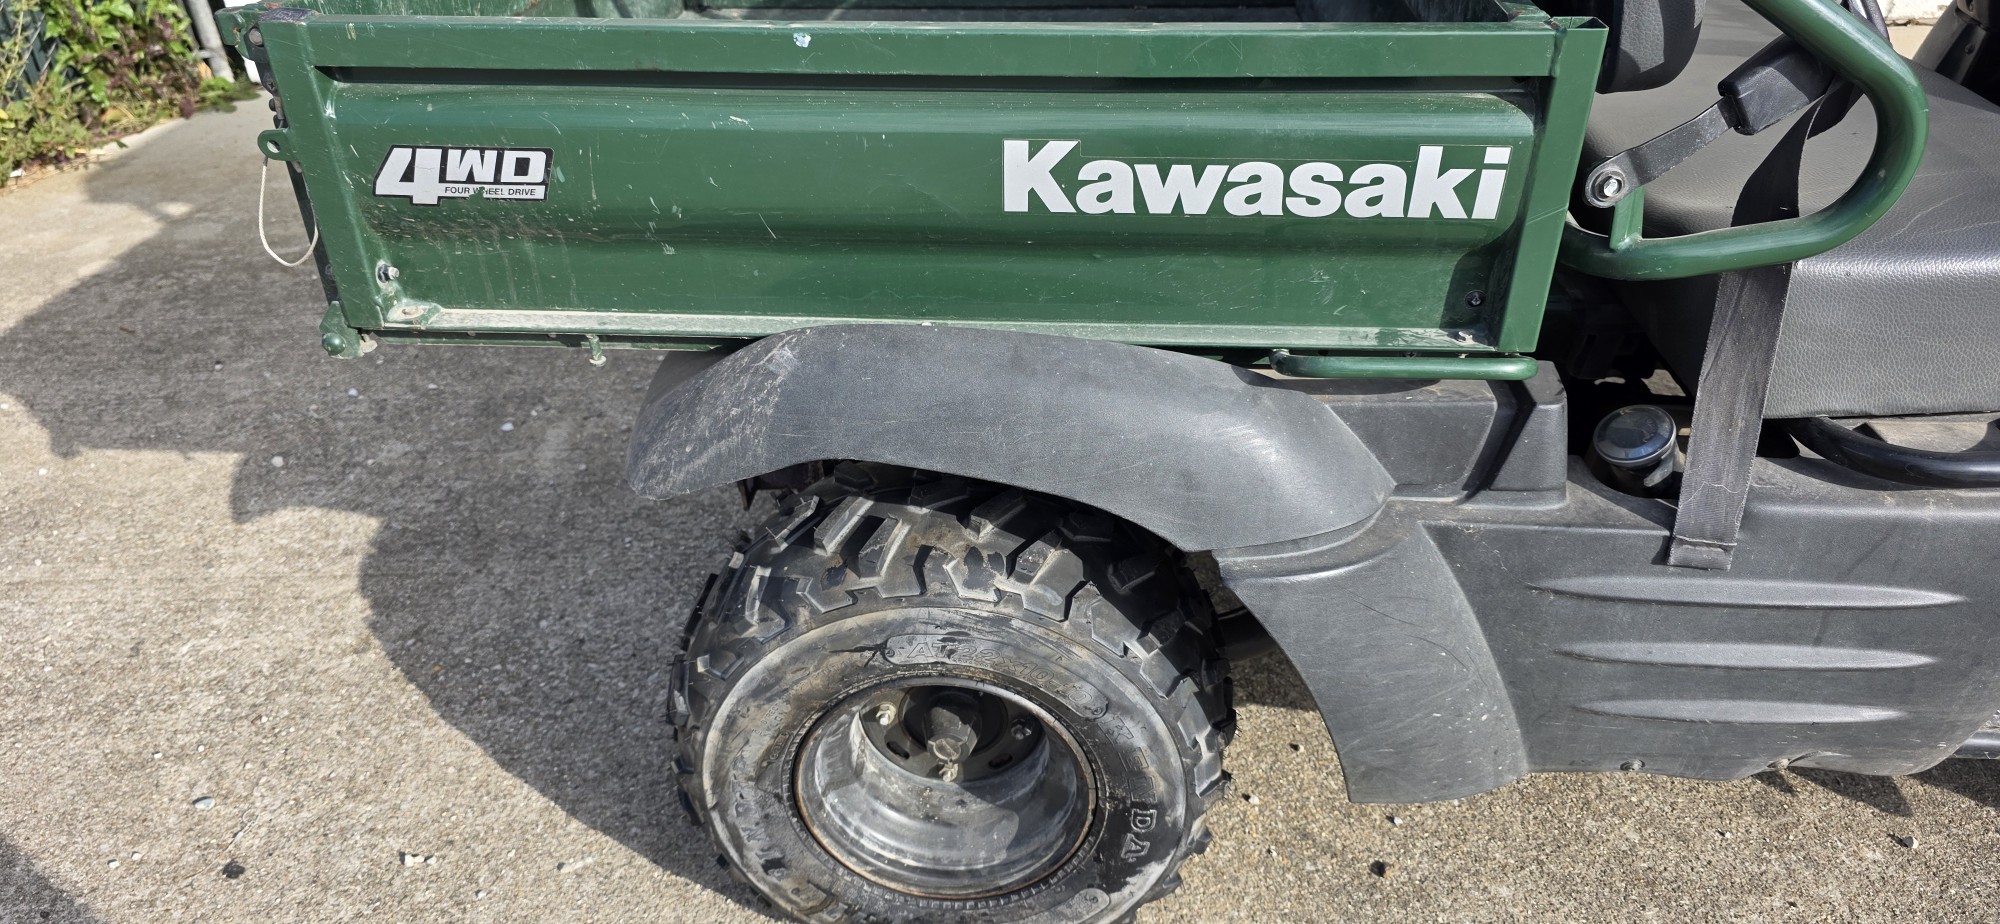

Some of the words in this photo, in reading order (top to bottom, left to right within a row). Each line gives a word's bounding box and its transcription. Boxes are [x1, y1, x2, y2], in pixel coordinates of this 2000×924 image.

[375, 147, 547, 205] 4WD
[444, 186, 470, 194] FOUR
[508, 188, 536, 196] DRIVE
[1003, 140, 1512, 219] Kawasaki
[1097, 714, 1158, 860] KENDA
